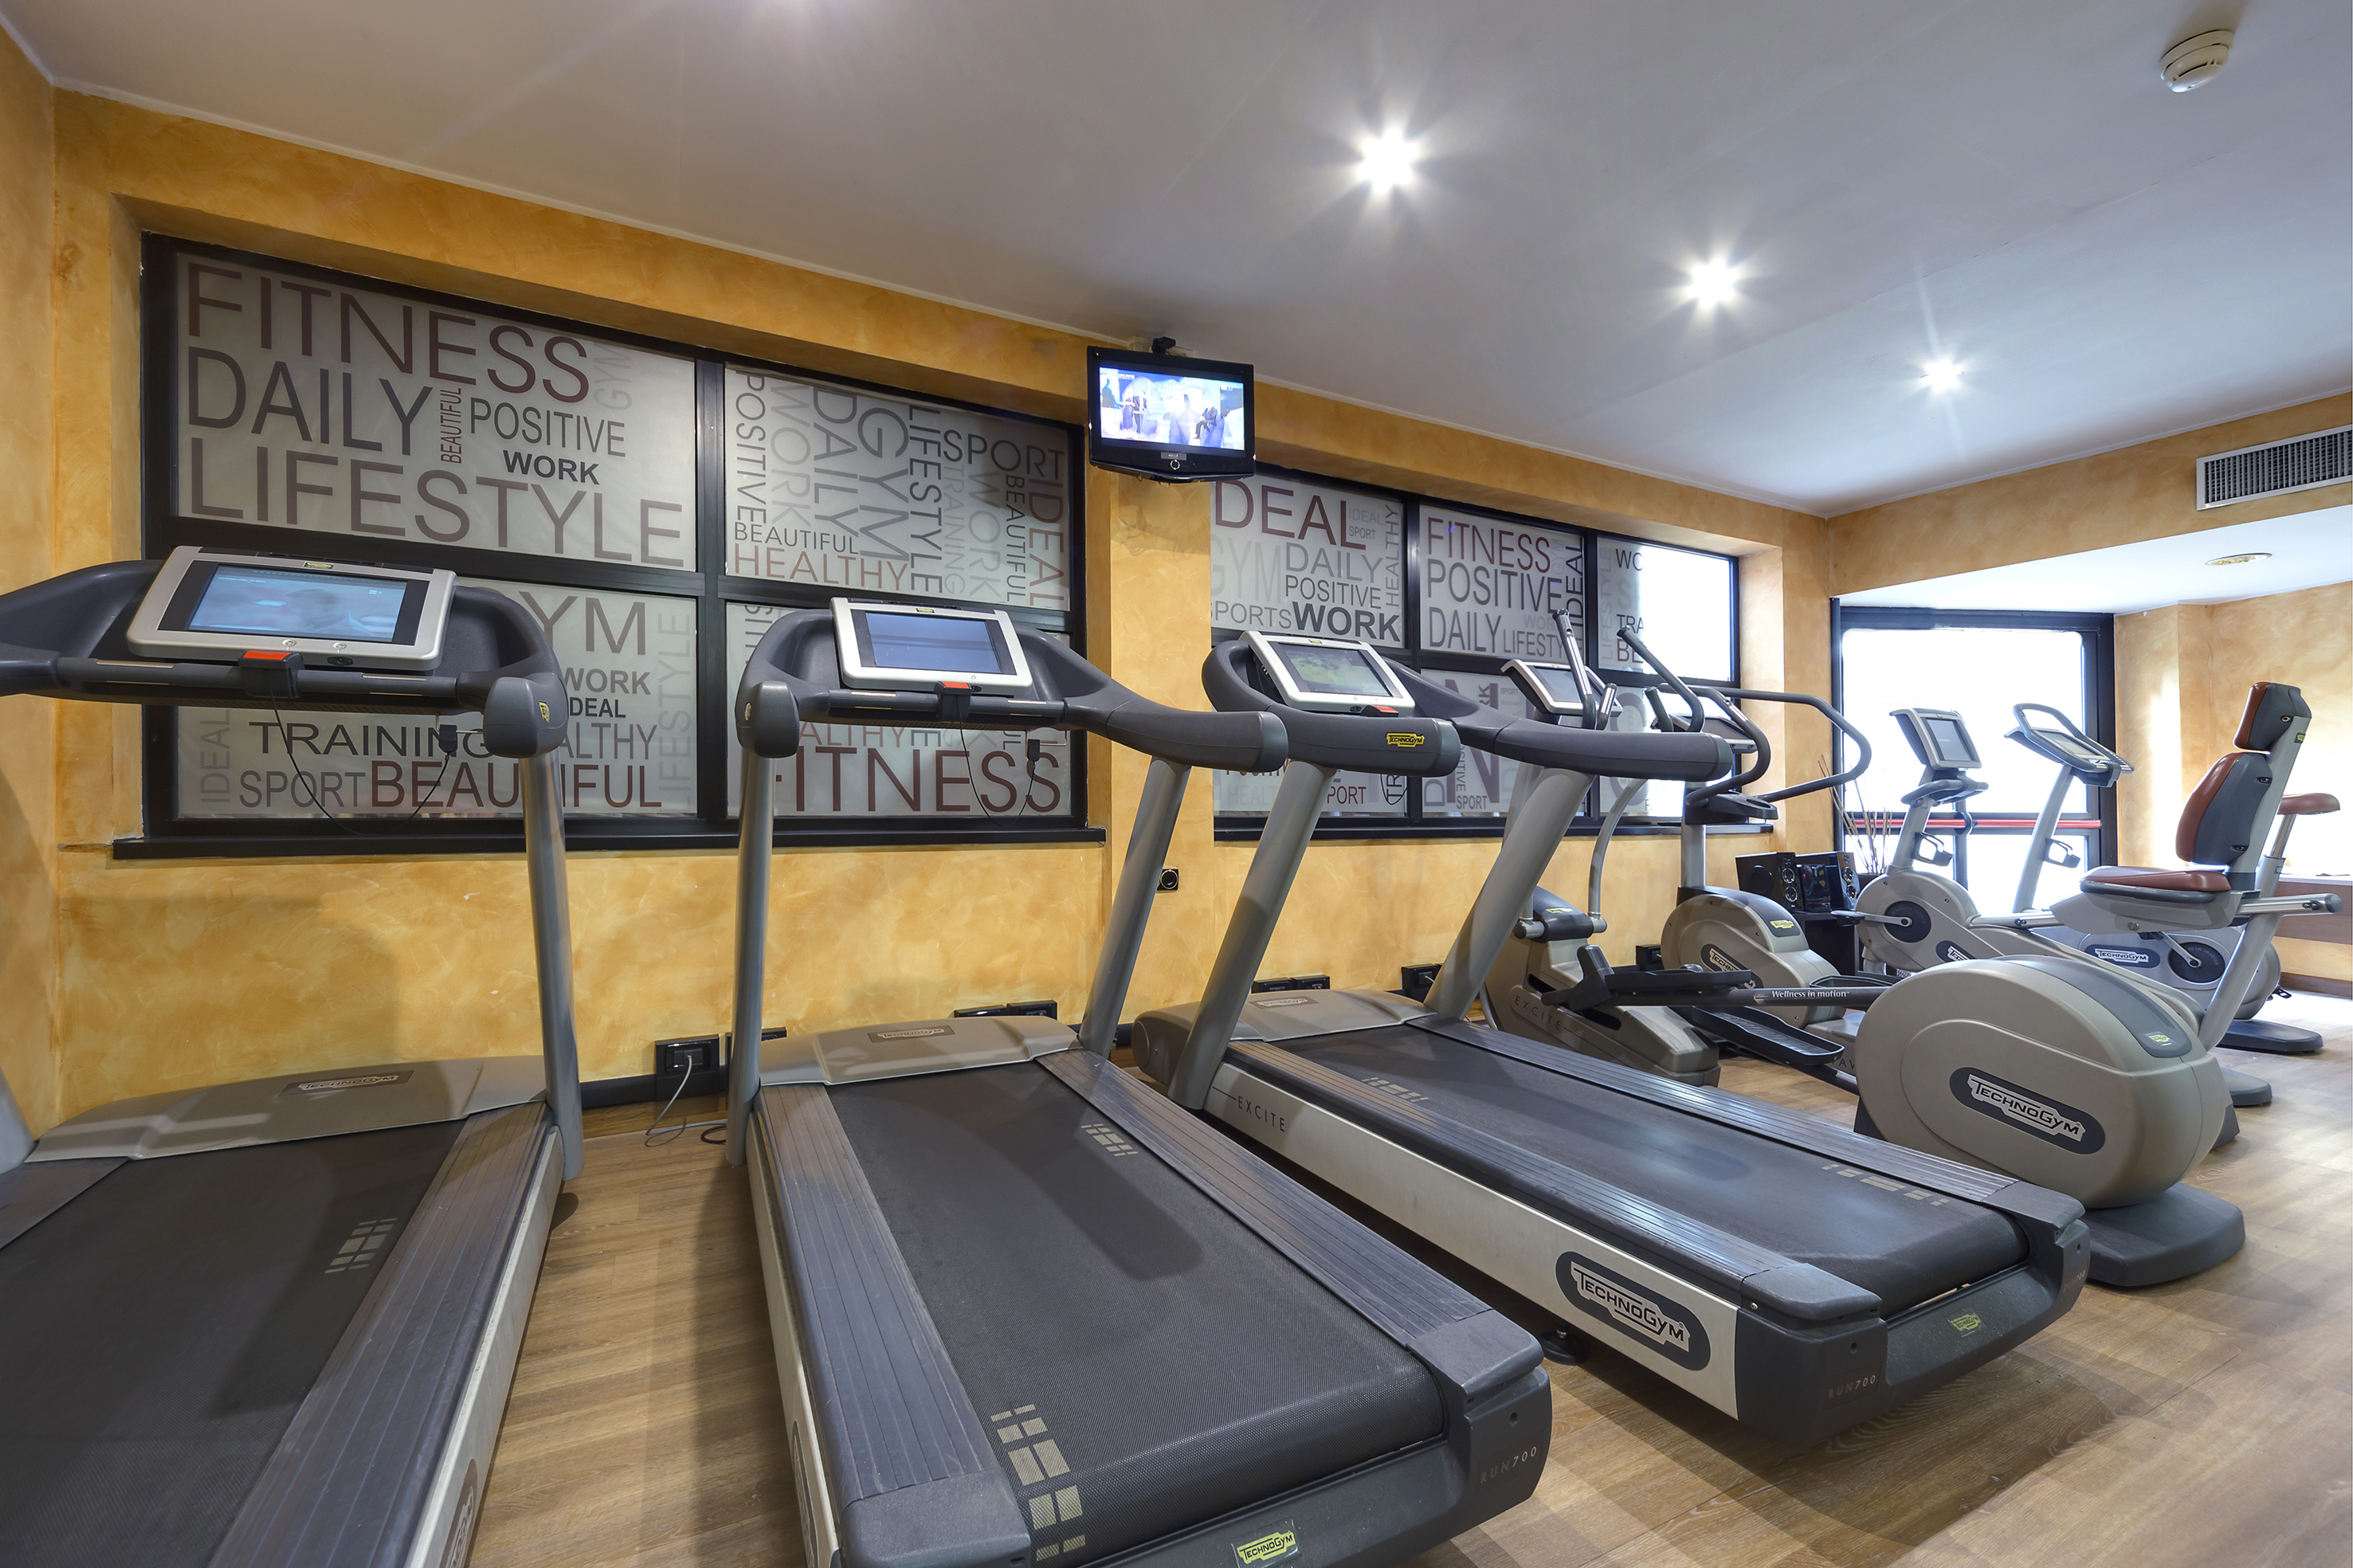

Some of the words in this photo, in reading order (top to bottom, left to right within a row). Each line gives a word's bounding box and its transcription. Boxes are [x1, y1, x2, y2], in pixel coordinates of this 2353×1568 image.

[188, 261, 589, 404] FITNESS
[188, 346, 433, 456] DAILY
[593, 343, 633, 410] GYM
[441, 387, 462, 464] BEAUTIFUL
[470, 397, 626, 458] POSITIVE
[735, 371, 767, 523] POSITIVE
[943, 429, 1065, 480] SPORT
[503, 449, 600, 485] WORK
[771, 385, 811, 528] WORK
[813, 386, 859, 538] DAILY
[857, 407, 909, 562] GYM
[191, 437, 684, 566] LIFESTYLE
[909, 404, 943, 594] LIFESTYLE
[1215, 480, 1367, 550] DEAL
[1348, 508, 1383, 525] IDEAL
[735, 522, 859, 555] BEAUTIFUL
[943, 464, 966, 595] TRAINING
[968, 472, 1002, 598] WORK
[1006, 474, 1026, 602] BEAUTIFUL
[1029, 479, 1065, 606] IDEAL
[1349, 525, 1376, 540] SPORT
[1385, 504, 1400, 607] HEALTHY
[1428, 517, 1551, 574] FITNESS
[735, 543, 908, 591] HEALTHY
[1285, 574, 1382, 610] POSITIVE
[1286, 542, 1383, 583] DAILY
[1427, 559, 1563, 614] POSITIVE
[1566, 538, 1583, 627] IDEAL
[519, 591, 646, 656] YM
[1292, 601, 1401, 642] WORK
[1429, 606, 1502, 653] DAILY
[1503, 629, 1563, 659] LIFESTY
[1524, 613, 1557, 631] WOR
[569, 697, 626, 719] DEAL
[200, 710, 230, 803] IDEAL
[371, 759, 662, 808] BEAUIFUL
[775, 745, 1061, 813] ITNESS
[239, 770, 366, 808] SPORT
[1327, 786, 1367, 805] PORT
[1457, 795, 1488, 809] SPORT
[1515, 994, 1562, 1031] EXCITE
[1237, 1095, 1285, 1133] EXCITE
